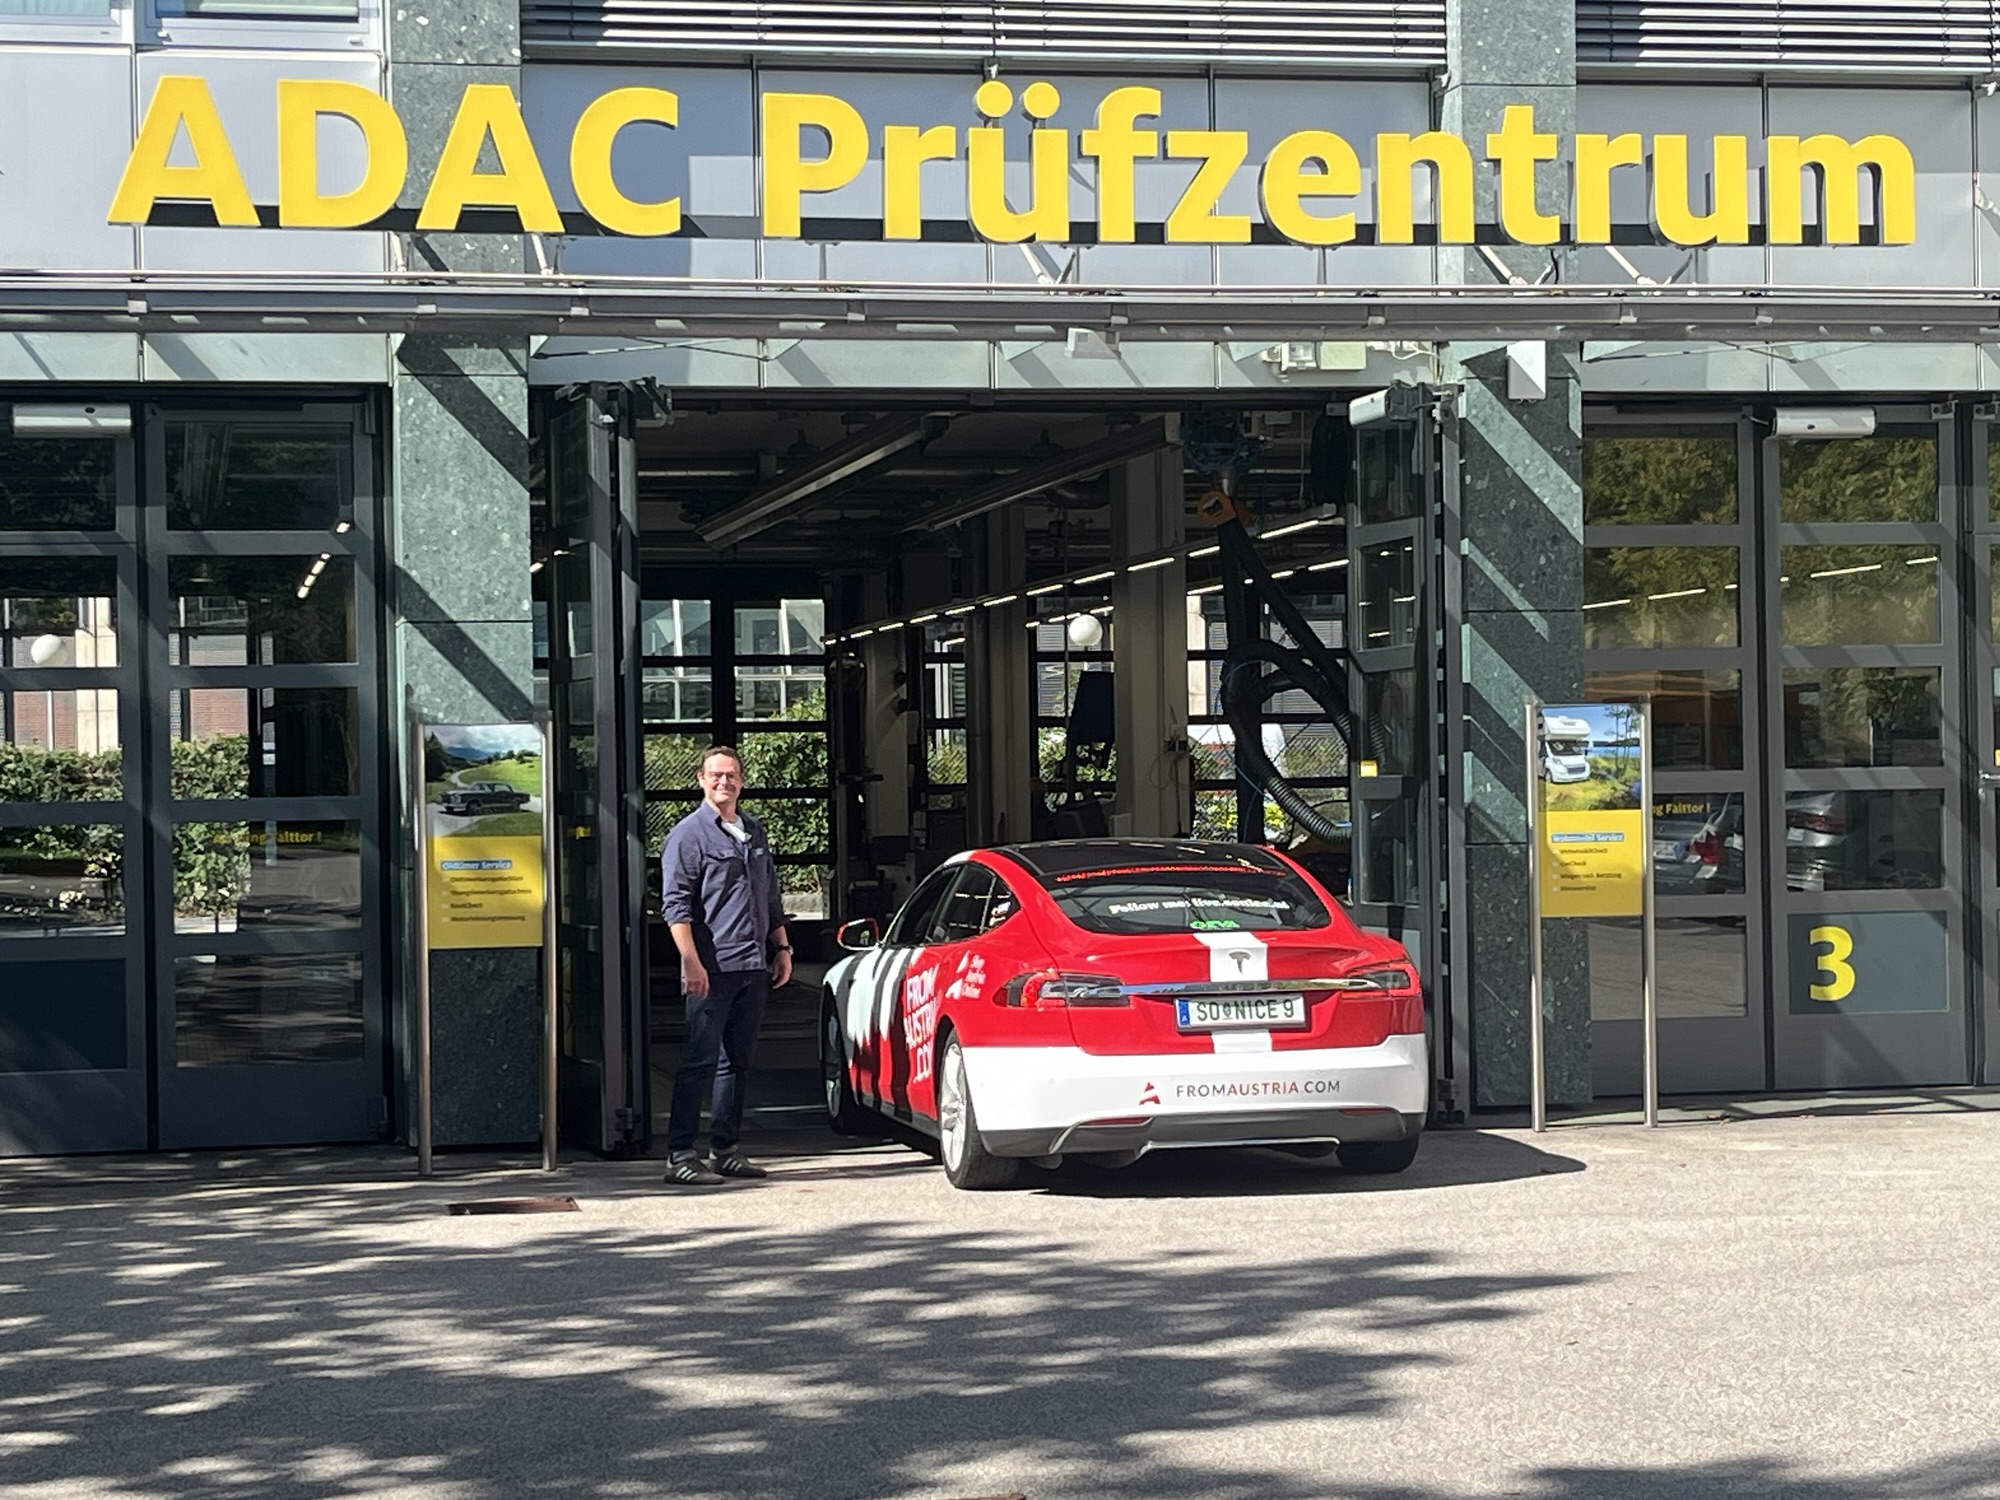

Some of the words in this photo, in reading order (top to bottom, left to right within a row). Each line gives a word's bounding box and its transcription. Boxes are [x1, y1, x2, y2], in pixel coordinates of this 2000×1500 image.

[107, 75, 682, 237] ADAC
[760, 81, 1916, 247] Prüfzentrum
[481, 860, 511, 869] Service
[1108, 900, 1160, 914] Follow
[1809, 925, 1856, 1002] 3
[1196, 1001, 1220, 1022] SO
[1235, 999, 1279, 1021] NICE
[1283, 999, 1294, 1018] 9
